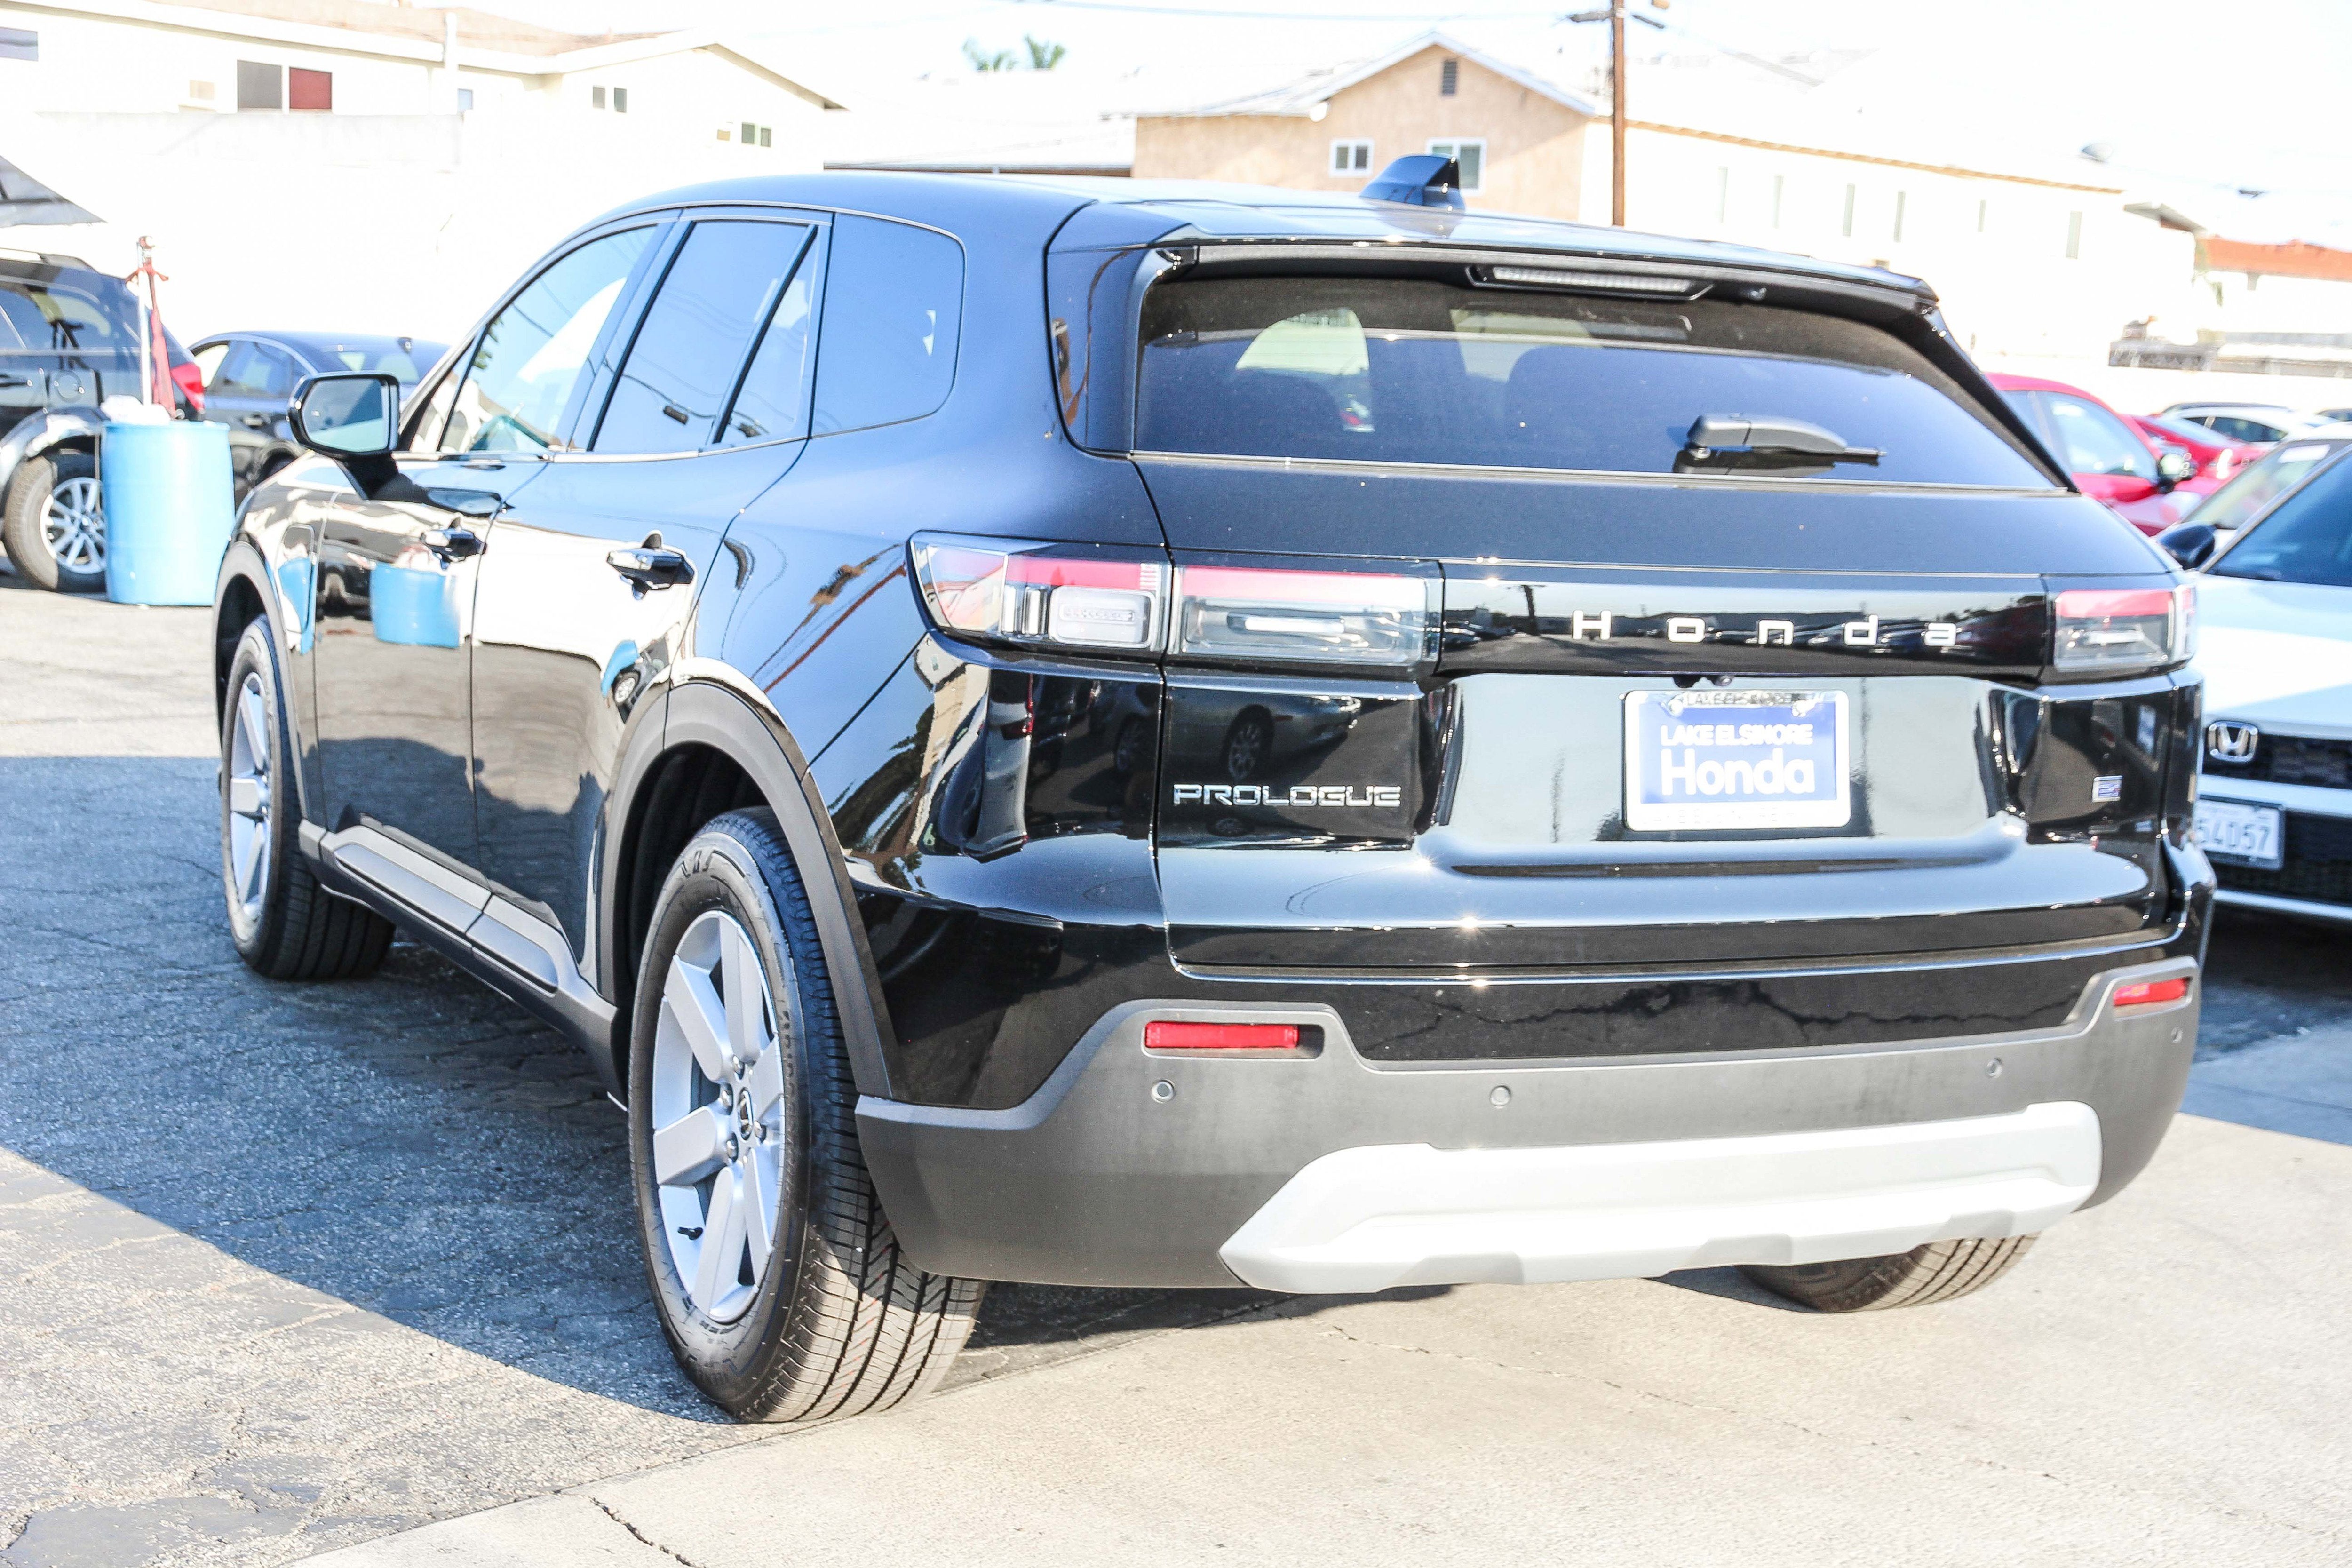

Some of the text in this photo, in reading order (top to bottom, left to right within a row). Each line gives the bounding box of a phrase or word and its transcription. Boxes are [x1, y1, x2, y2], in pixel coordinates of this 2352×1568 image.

[1572, 610, 1957, 646] Honda
[1660, 724, 1814, 746] LAKE ELSINORE
[1660, 747, 1815, 796] Honda
[1173, 783, 1402, 807] PROLOGUE
